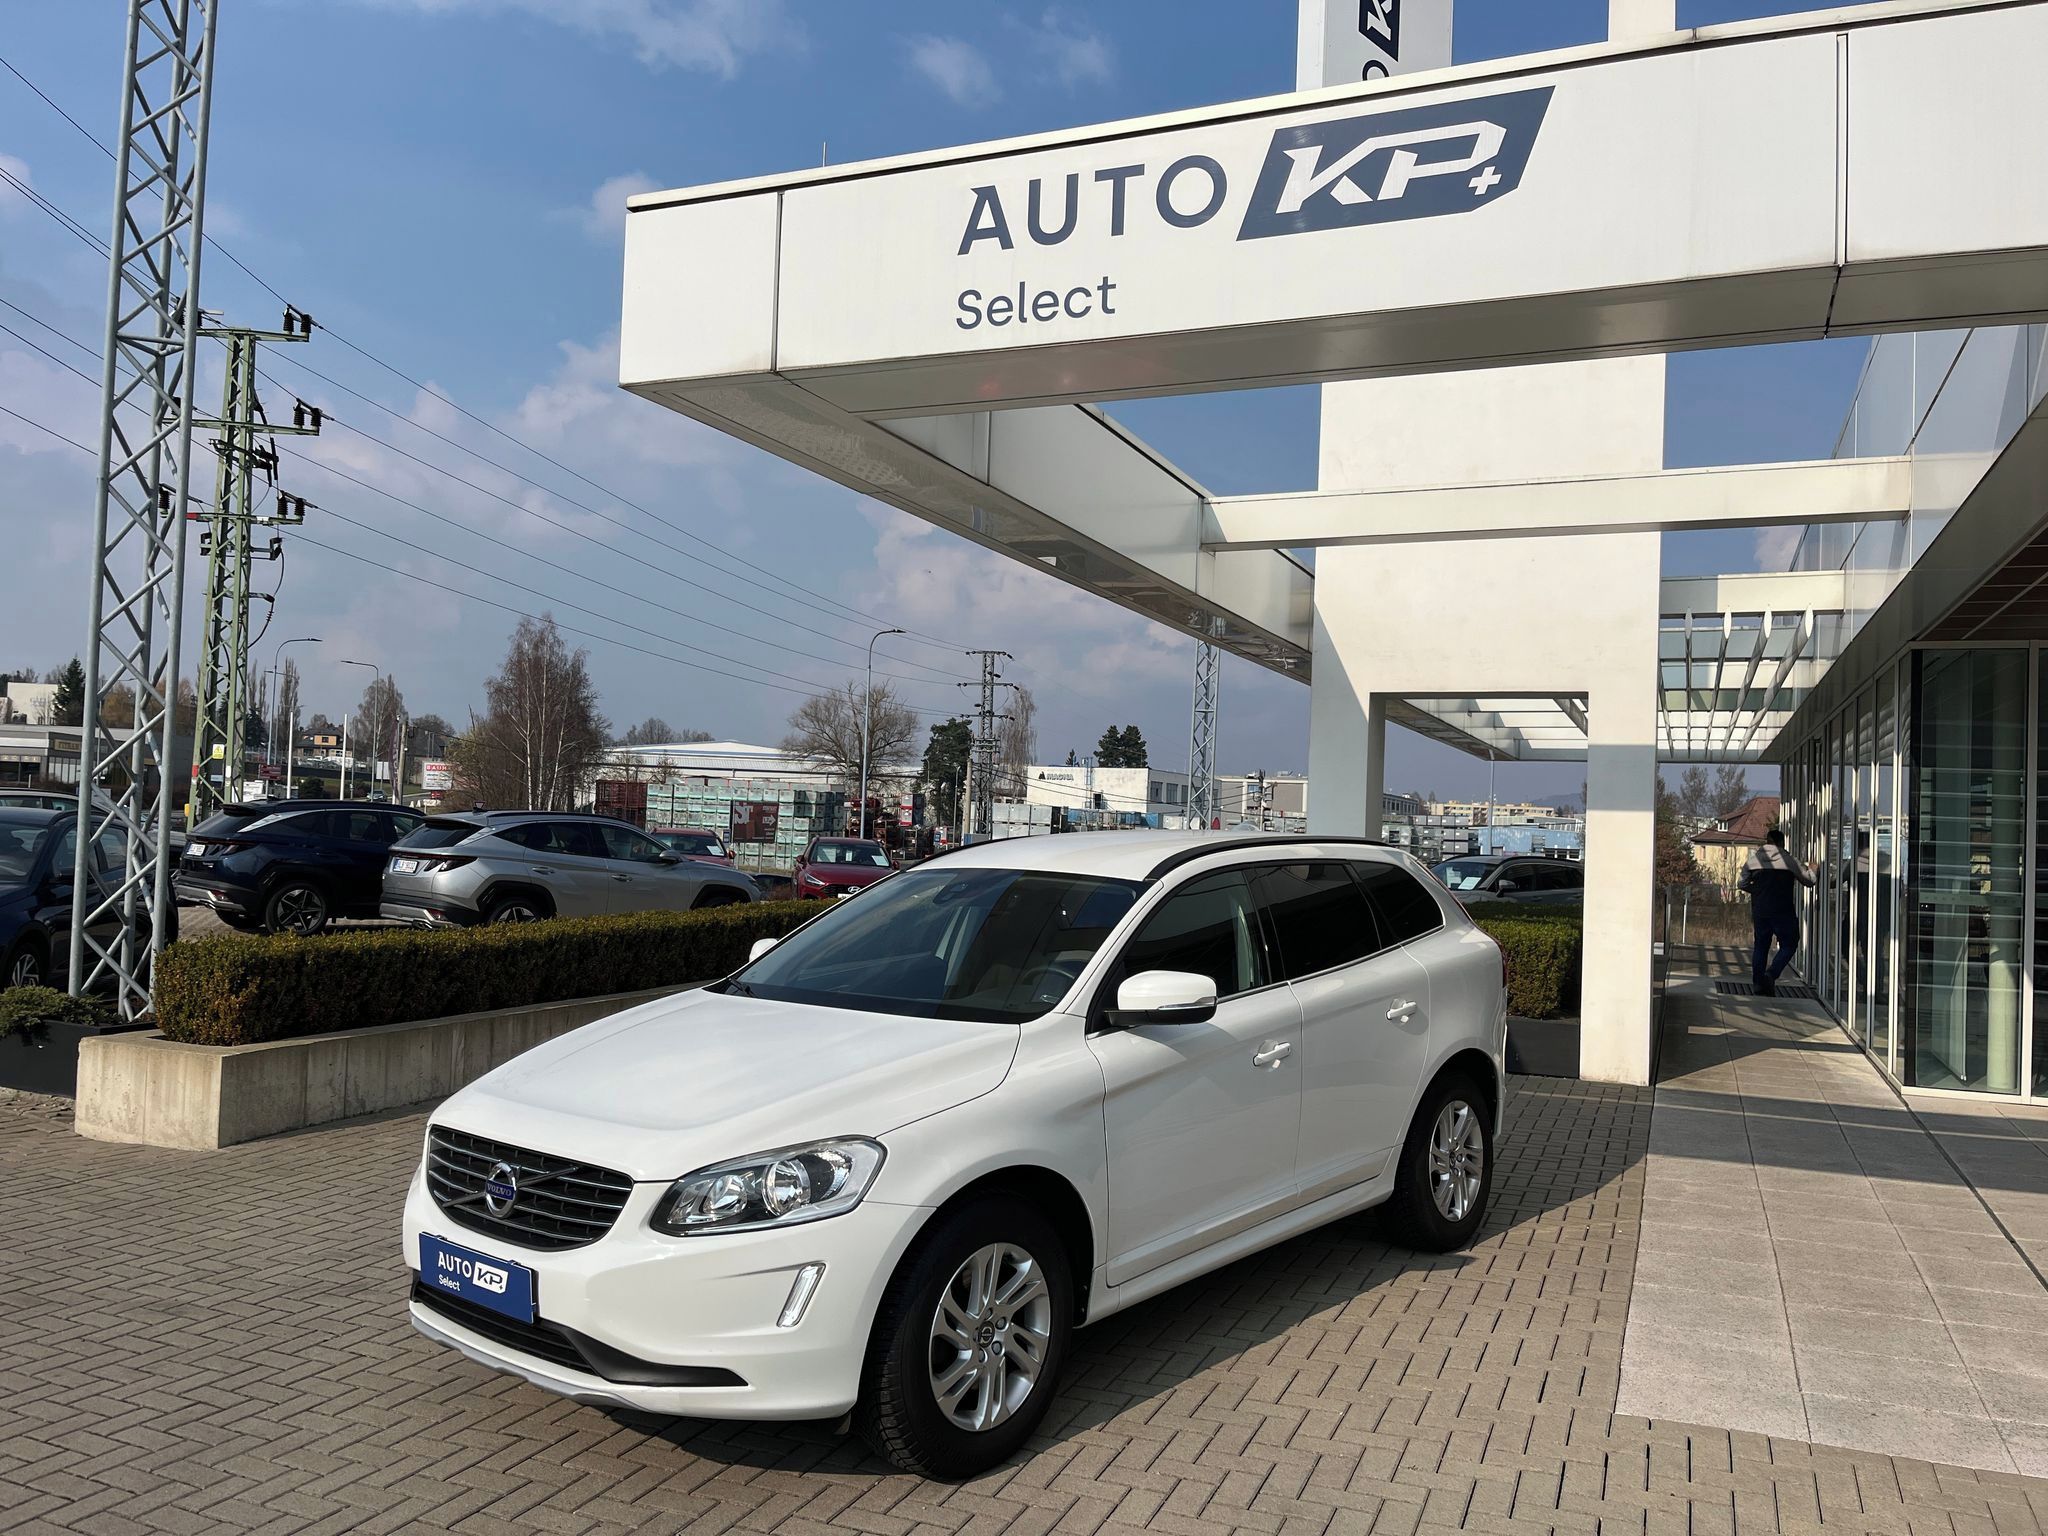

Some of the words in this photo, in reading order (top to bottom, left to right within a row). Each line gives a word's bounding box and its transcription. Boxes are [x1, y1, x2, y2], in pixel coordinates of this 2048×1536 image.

[957, 154, 1228, 256] AUTO
[955, 275, 1118, 331] Select
[487, 1182, 512, 1197] VOLVO
[438, 1251, 472, 1278] AUTO
[438, 1274, 460, 1291] Select
